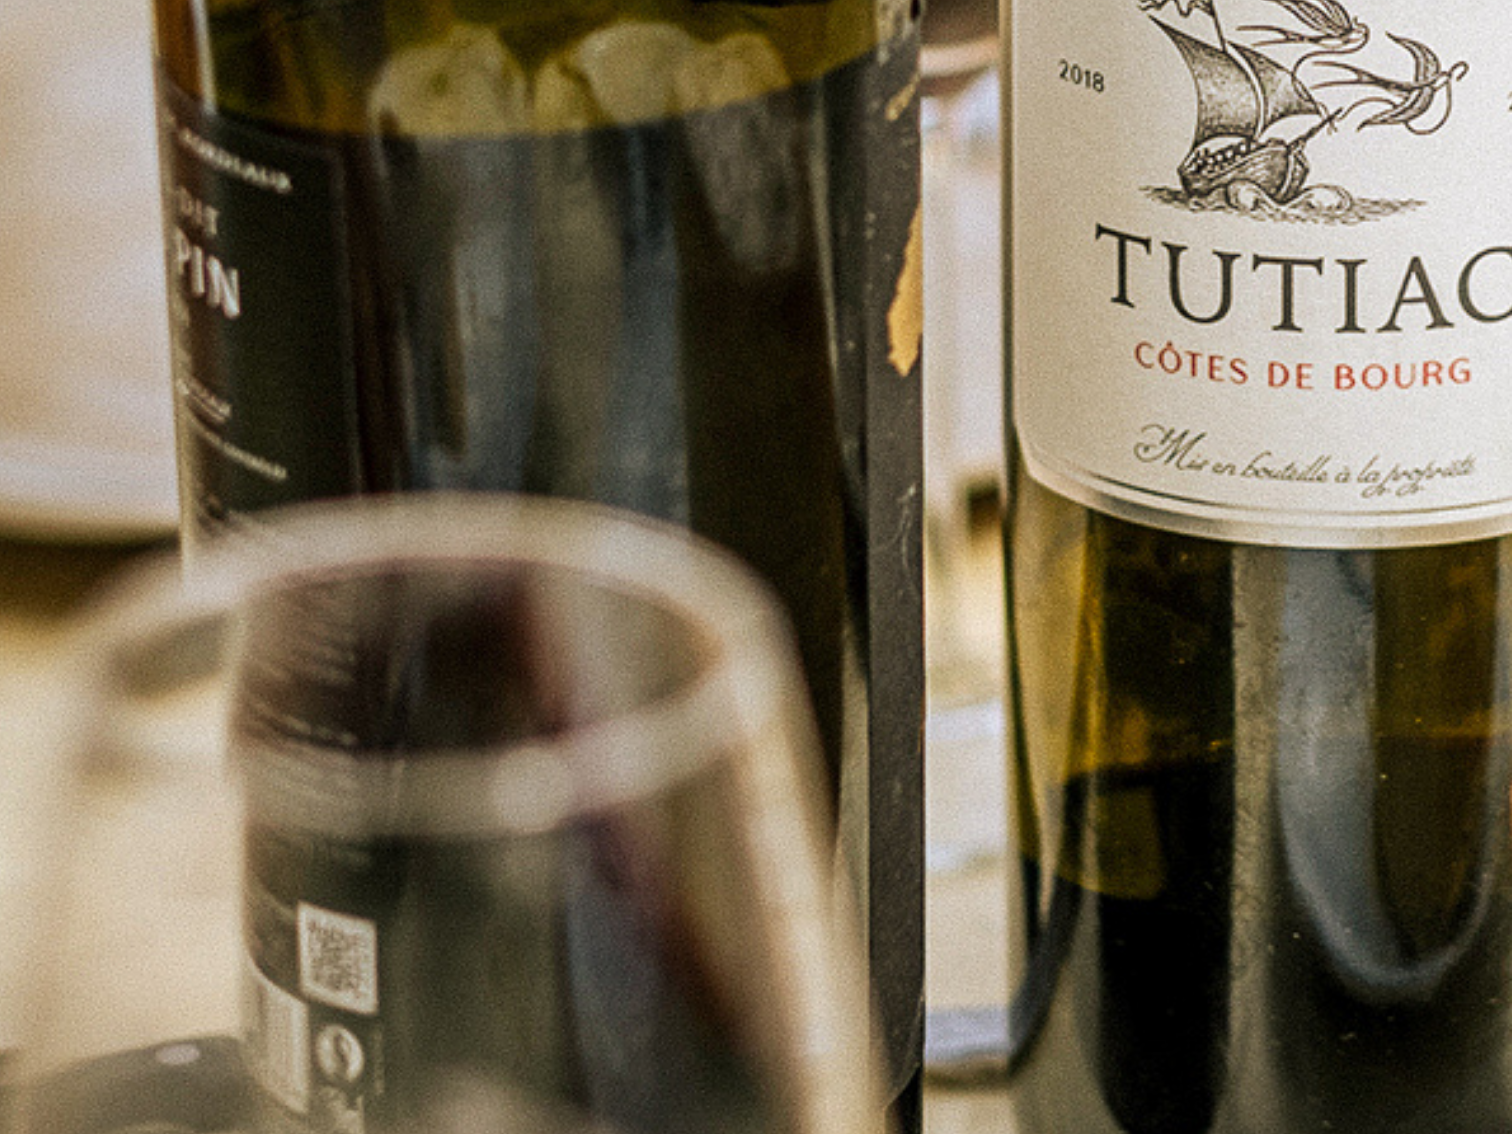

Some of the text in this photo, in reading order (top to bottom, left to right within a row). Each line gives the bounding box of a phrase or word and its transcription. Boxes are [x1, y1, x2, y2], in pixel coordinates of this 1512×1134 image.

[1058, 58, 1105, 94] 2018
[1134, 340, 1471, 391] CÔTES DE BOURG
[1133, 423, 1209, 471] Mis
[1211, 462, 1237, 476] en
[1357, 454, 1381, 483] la
